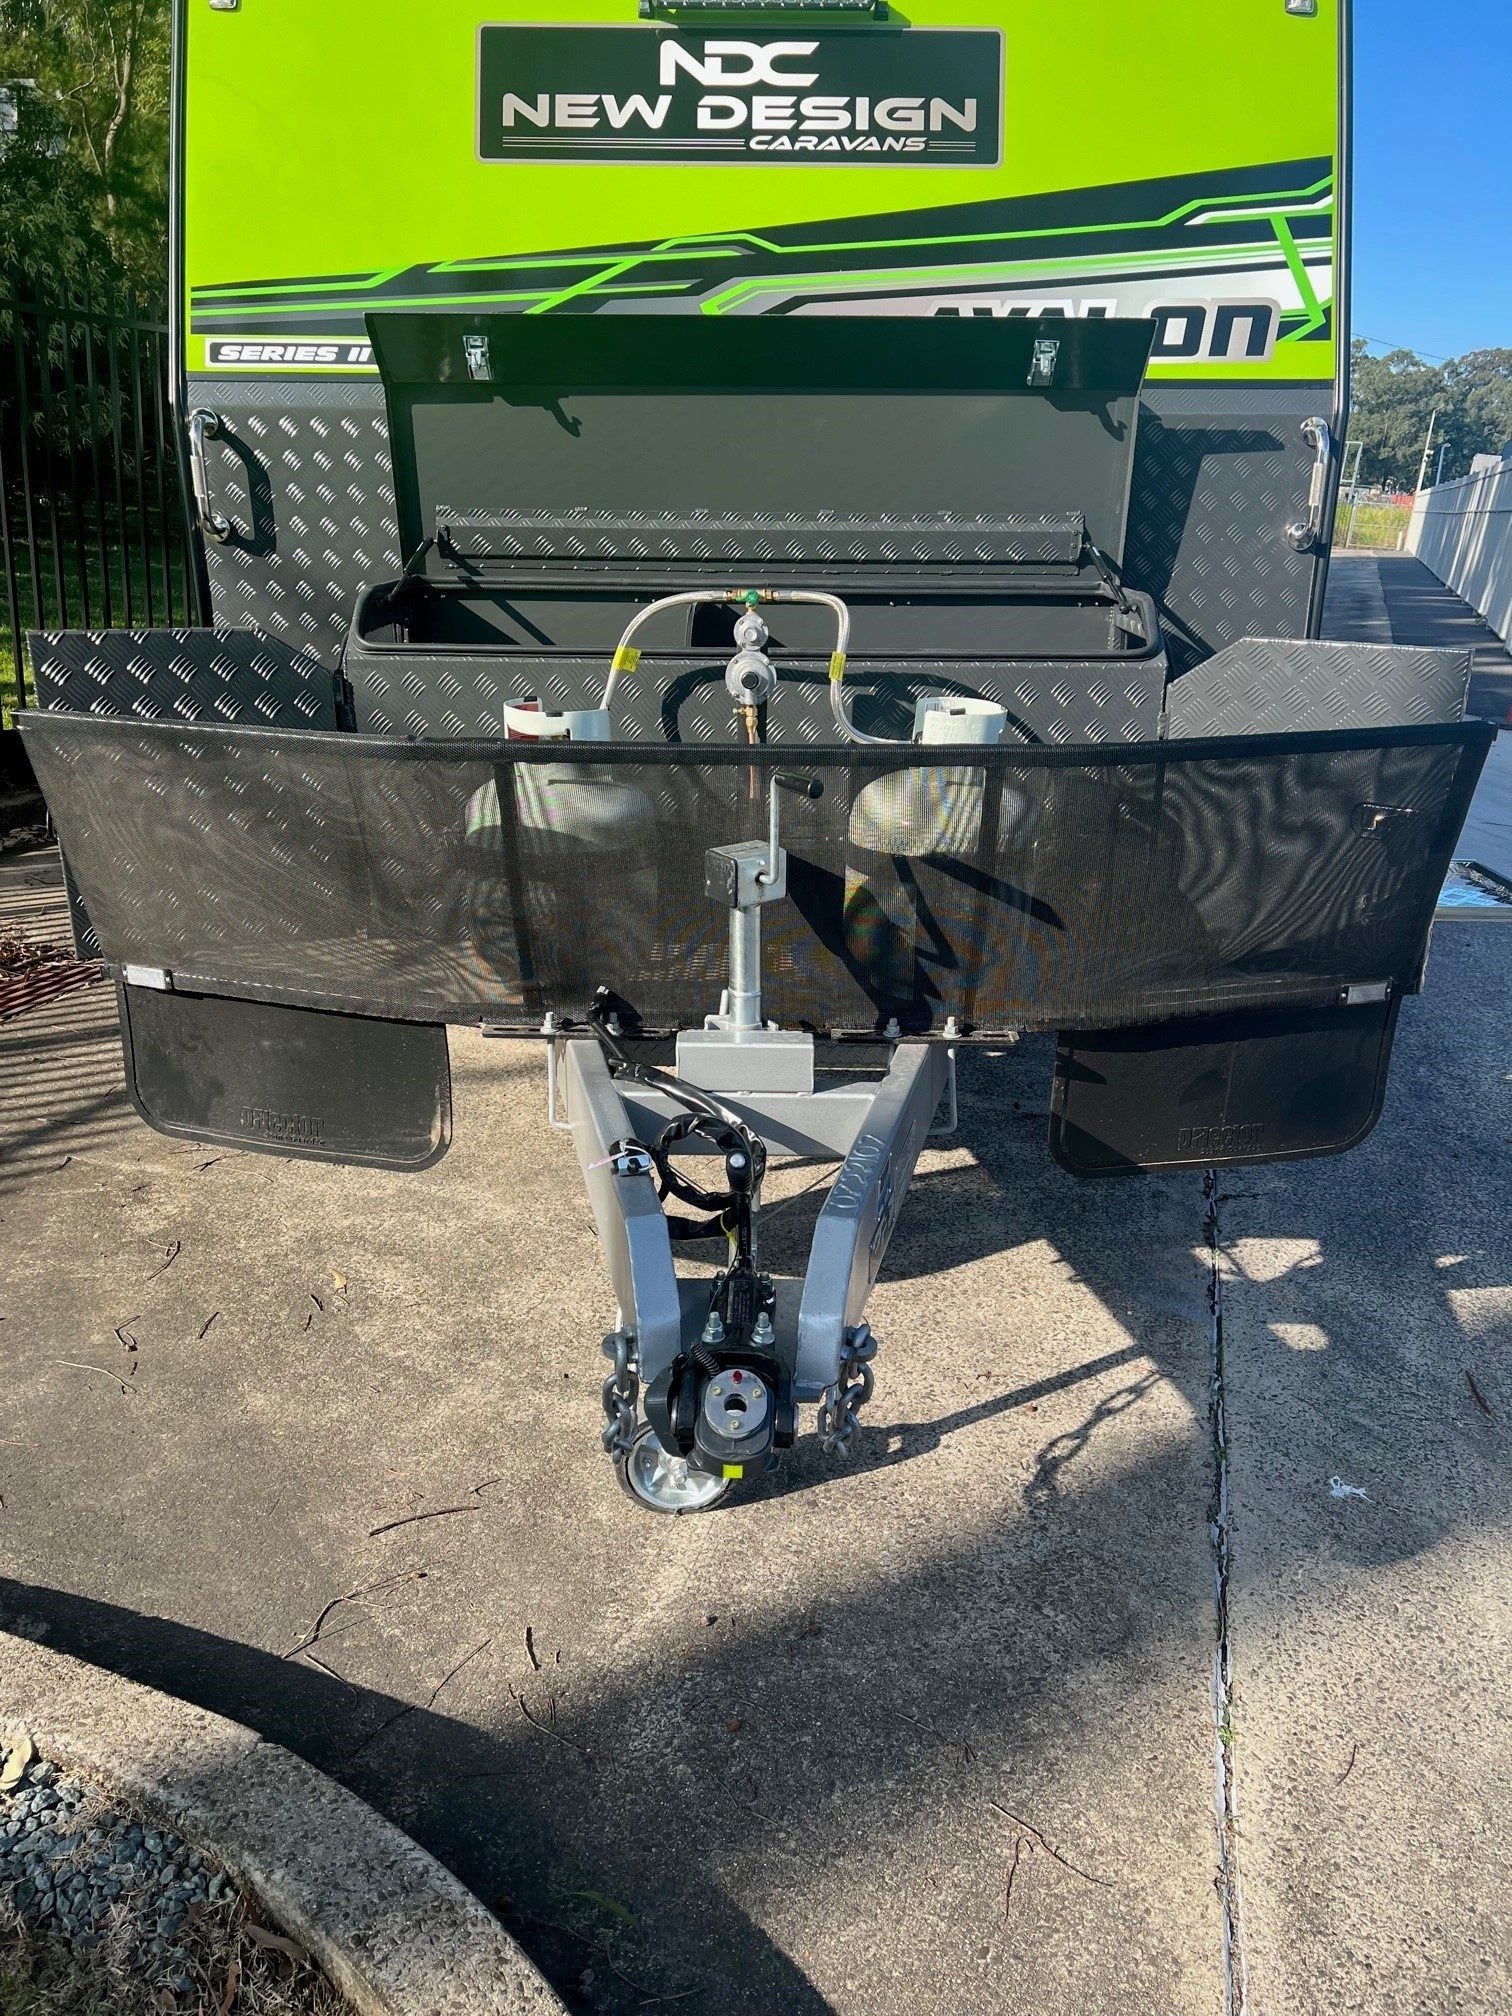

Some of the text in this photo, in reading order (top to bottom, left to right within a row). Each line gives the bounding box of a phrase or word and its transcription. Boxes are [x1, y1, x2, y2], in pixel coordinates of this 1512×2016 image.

[659, 39, 820, 87] NDC
[502, 92, 977, 132] NEW DESIGN
[748, 135, 928, 152] CARAVANS
[217, 345, 339, 362] SERIES
